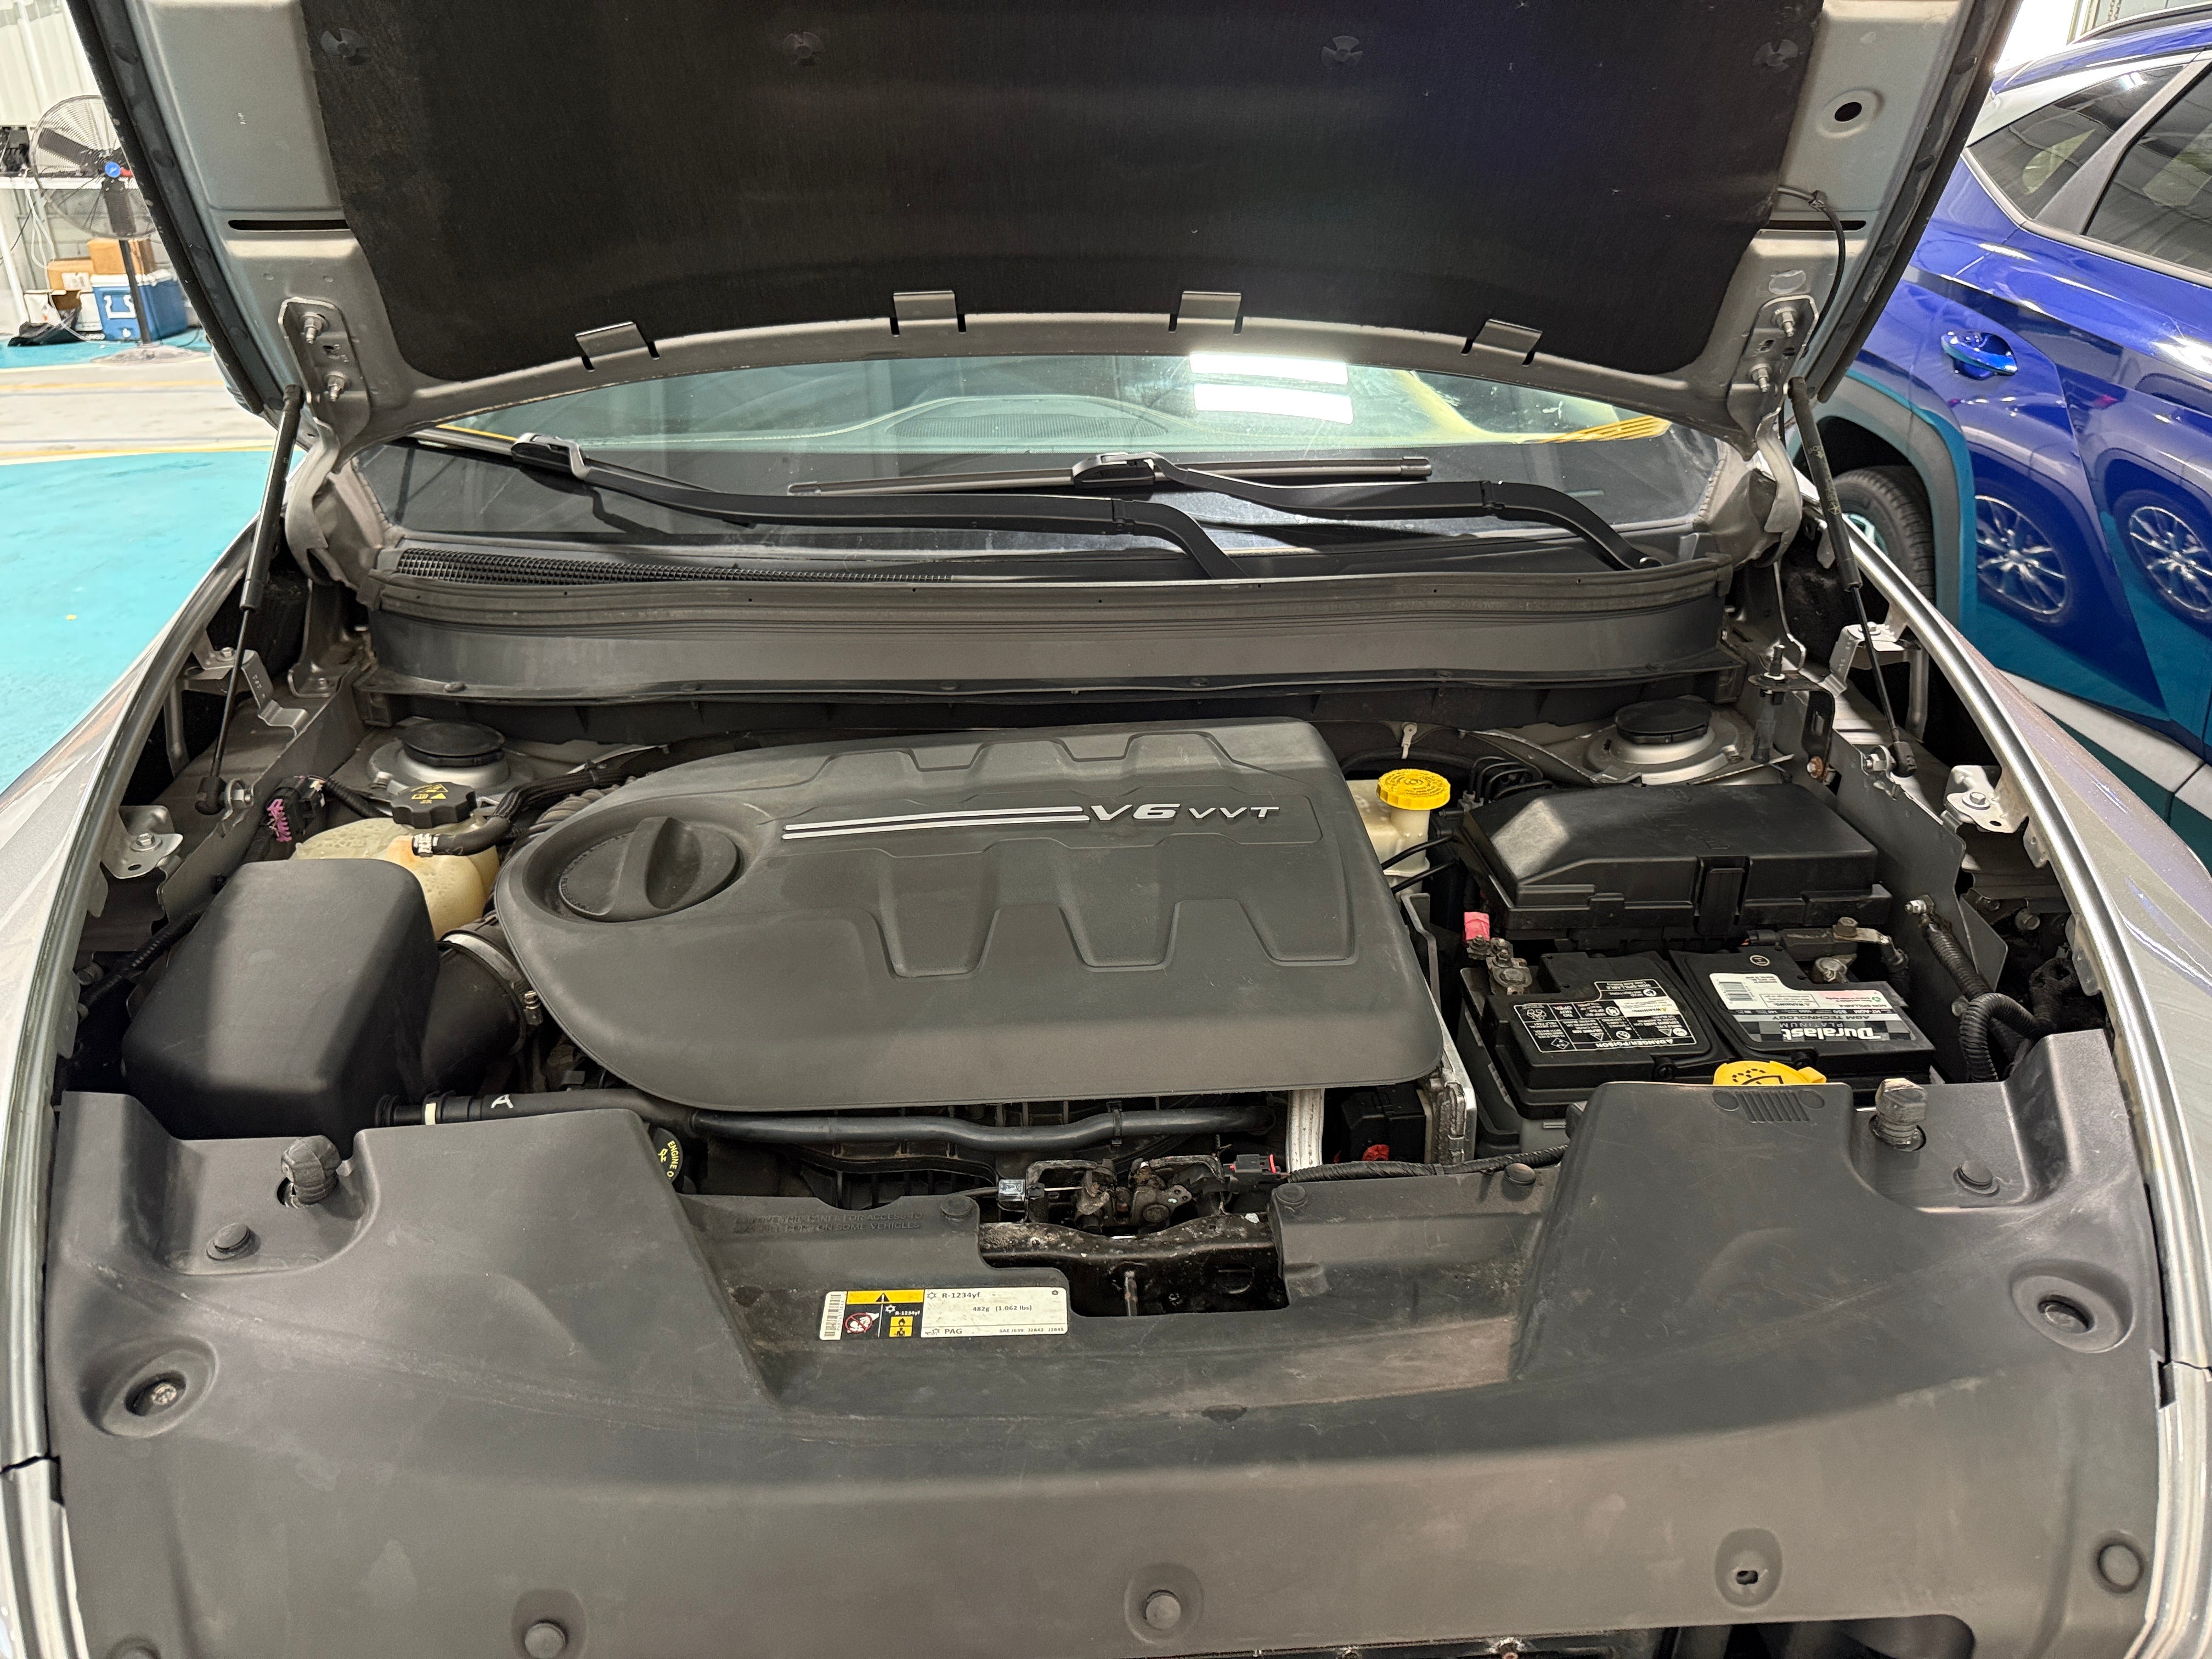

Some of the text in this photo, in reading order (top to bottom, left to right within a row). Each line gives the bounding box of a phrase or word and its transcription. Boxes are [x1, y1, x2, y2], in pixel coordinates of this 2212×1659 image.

[1091, 803, 1280, 821] V6 VVT
[1781, 1027, 1881, 1040] Duralast
[490, 1094, 514, 1108] A
[667, 1140, 679, 1169] ENGINE
[867, 1212, 906, 1221] ACCESS
[870, 1221, 921, 1229] VEHICLES
